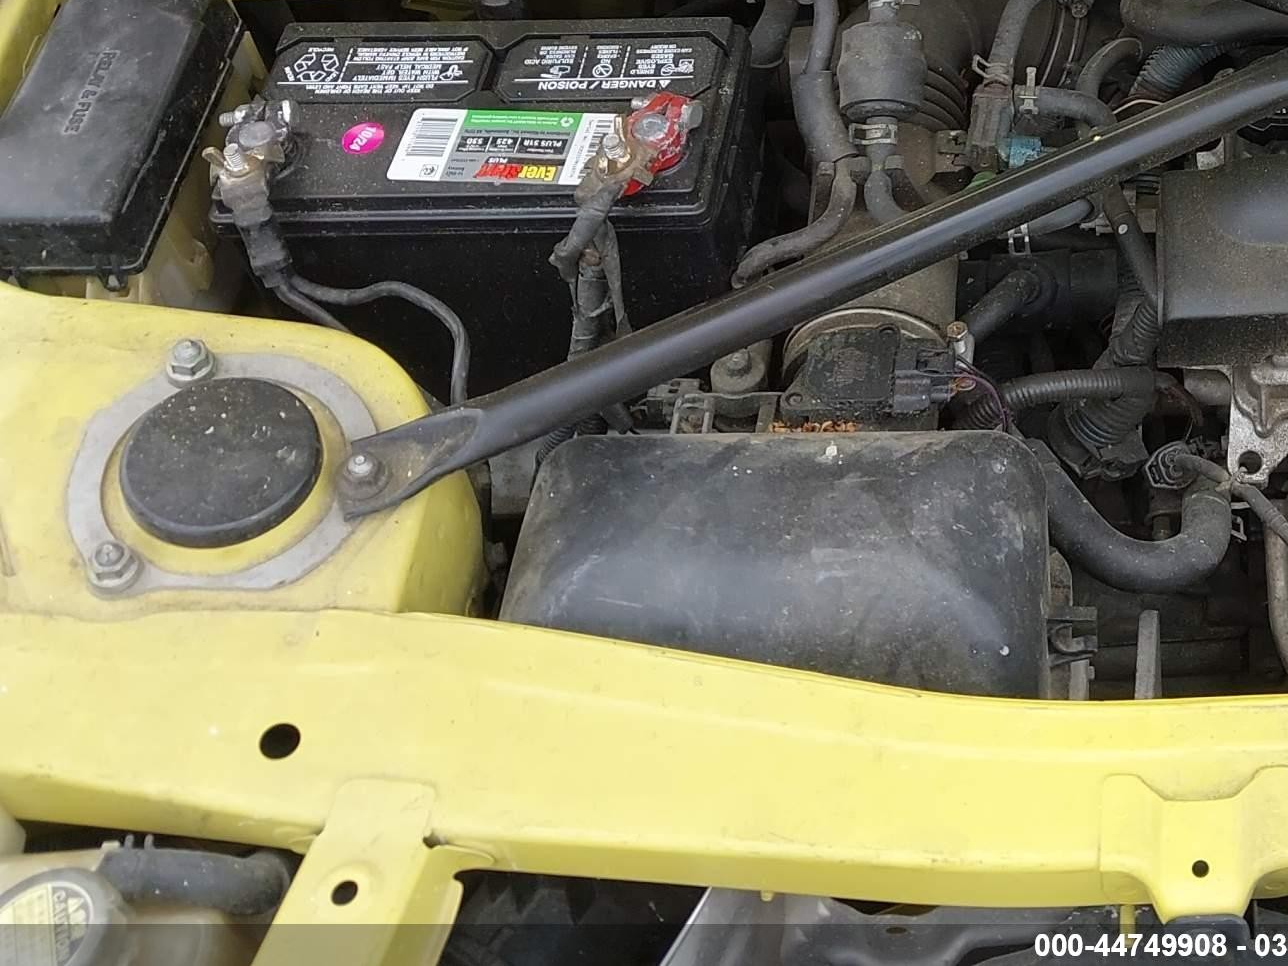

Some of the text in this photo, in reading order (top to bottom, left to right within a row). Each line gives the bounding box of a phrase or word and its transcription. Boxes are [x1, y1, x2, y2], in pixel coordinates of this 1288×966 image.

[538, 81, 588, 90] POISON
[602, 80, 656, 88] DANGER
[64, 50, 120, 134] RELAY & FUSE
[474, 164, 557, 181] EverStart
